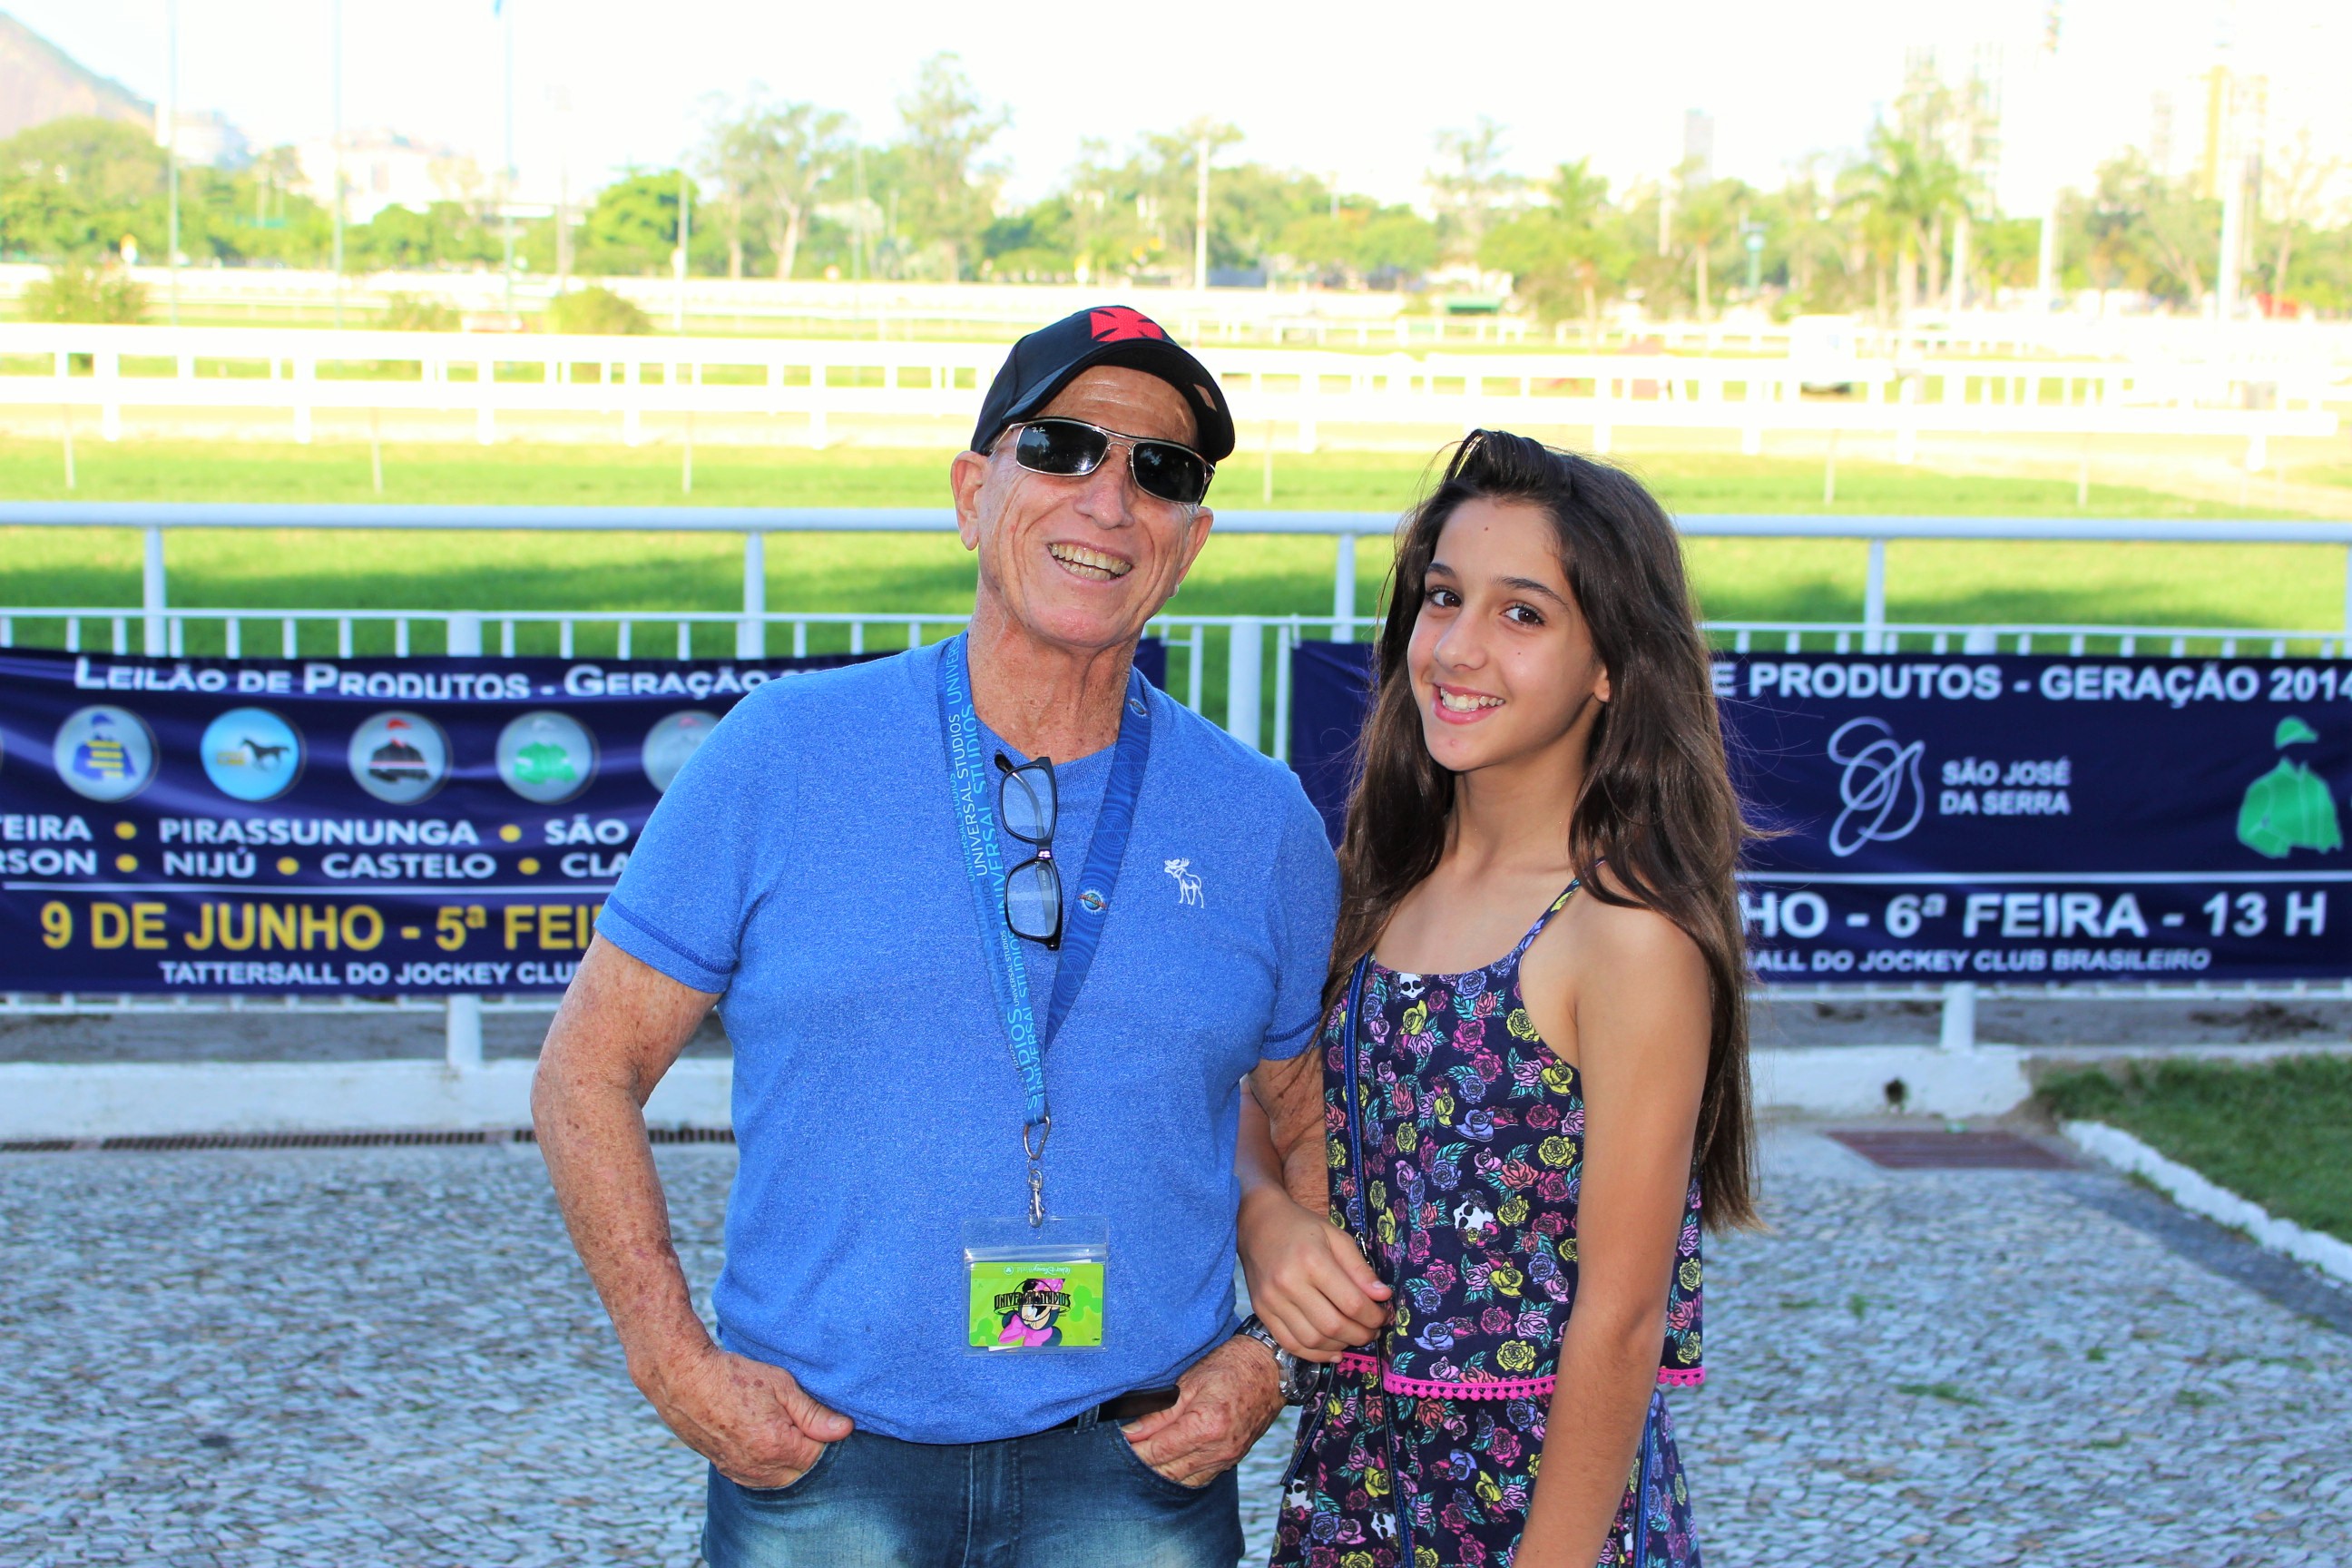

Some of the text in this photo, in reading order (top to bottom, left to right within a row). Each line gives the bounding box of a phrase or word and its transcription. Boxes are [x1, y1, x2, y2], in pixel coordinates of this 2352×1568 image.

[74, 658, 228, 693] LEILÃO
[238, 671, 290, 693] DE
[303, 662, 530, 700] PRODUTOS
[564, 663, 769, 700] GERAÇÃO
[1711, 662, 1737, 698] E
[1749, 662, 2001, 700] PRODUTOS
[2040, 662, 2258, 708] GERAÇÃO
[948, 714, 968, 779] STUDIOS
[962, 704, 988, 794] STUDIOS
[1943, 759, 2071, 786] SÃO JOSÉ
[1940, 790, 2070, 815] DA SERRA
[0, 813, 630, 847] EIRA PIRASSUNUNGA SÃO
[949, 772, 975, 882] UNIVERSAL STUDIOS
[961, 781, 988, 876] UNIVERSAL
[162, 845, 256, 878] NIJÚ
[321, 851, 496, 878] CASTELO
[41, 901, 73, 949] 9
[91, 902, 168, 949] DE
[184, 904, 384, 952] JUNHO
[505, 906, 602, 950] FEI
[981, 878, 998, 930] STUDIOS
[1738, 890, 1829, 938] HO
[1963, 893, 2147, 937] FEIRA
[2203, 893, 2268, 936] 13
[2285, 892, 2326, 936] H
[159, 961, 581, 985] TATTERSALL DO JOCKEY CLU
[1000, 930, 1020, 1006] UNIVERSAL STUDIOS
[1812, 950, 1854, 972] DO
[1859, 950, 1967, 972] JOCKEY
[1974, 950, 2045, 971] CLUB
[2053, 949, 2210, 971] BRASILEIRO
[1006, 1008, 1038, 1110] STUDIOS
